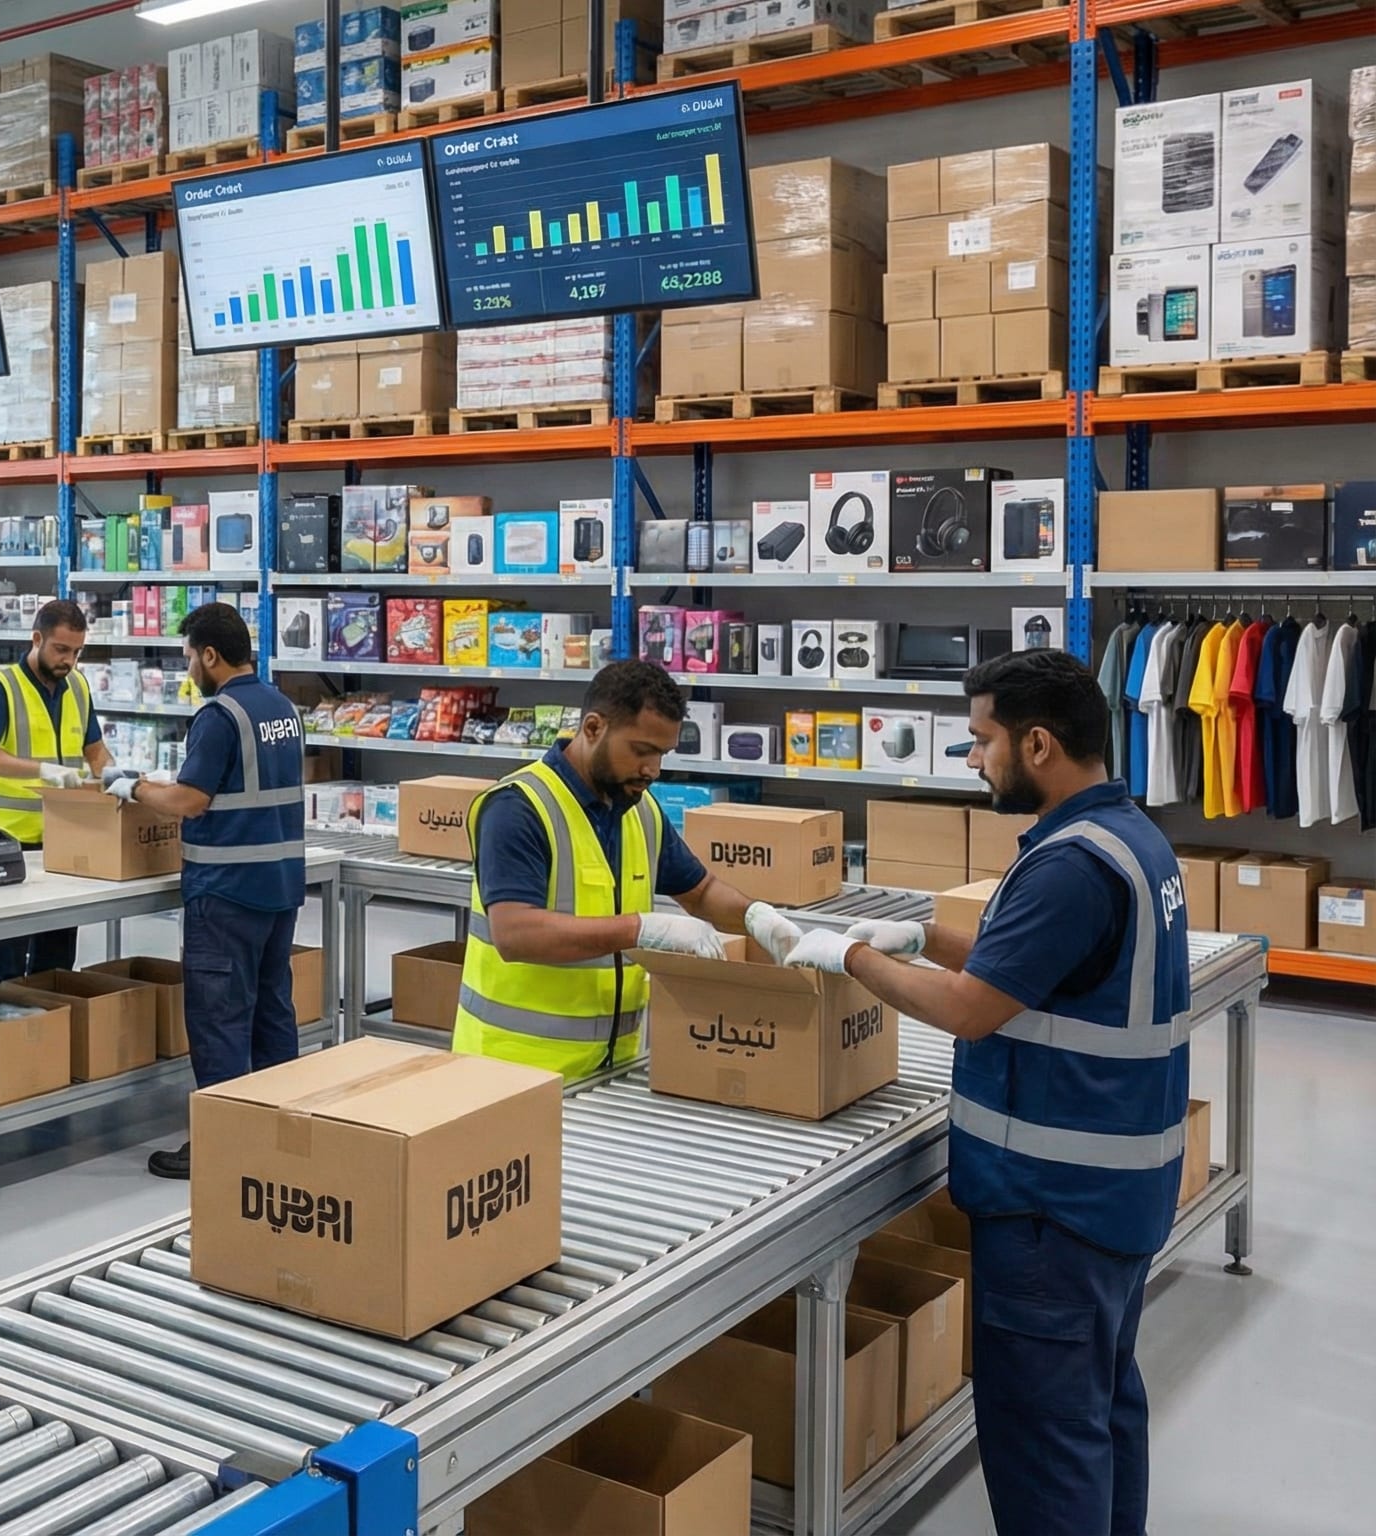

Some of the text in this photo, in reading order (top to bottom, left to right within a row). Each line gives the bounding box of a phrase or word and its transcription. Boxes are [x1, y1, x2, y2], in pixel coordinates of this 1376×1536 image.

[444, 141, 481, 156] Order
[184, 188, 213, 202] Order
[259, 717, 299, 745] DUBAI
[710, 841, 772, 868] DUBAI
[841, 1002, 883, 1050] DUBAI
[241, 1175, 353, 1245] DUBAI
[447, 1153, 530, 1240] DUBAI
